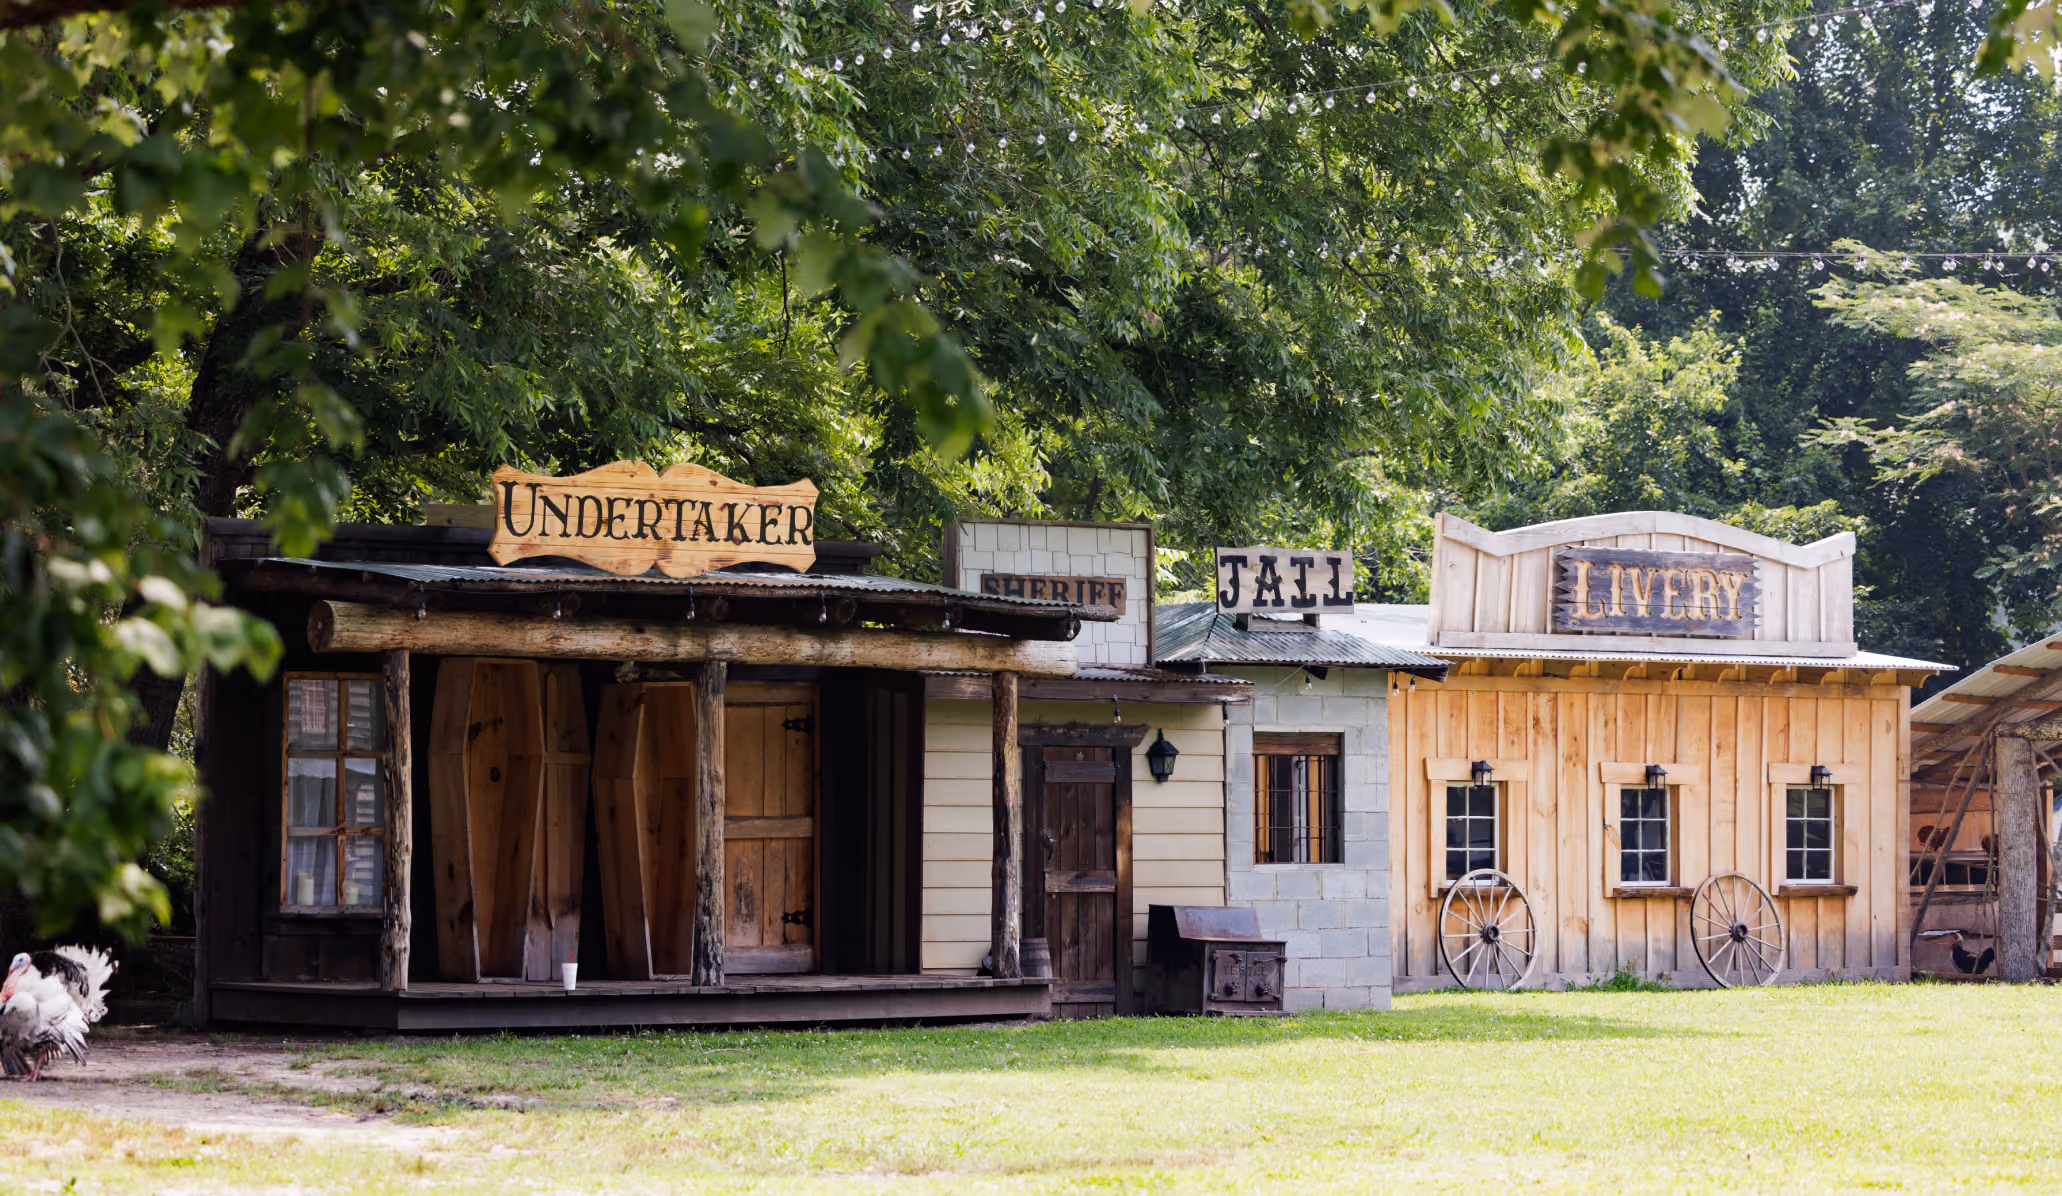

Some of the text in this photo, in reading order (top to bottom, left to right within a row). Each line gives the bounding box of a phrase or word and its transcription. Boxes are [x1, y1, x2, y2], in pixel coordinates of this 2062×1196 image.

[499, 480, 814, 546] UNDERTAKER
[983, 576, 1125, 608] SHERIFF
[1219, 555, 1354, 609] JAIL
[1569, 560, 1748, 621] LIVERY
